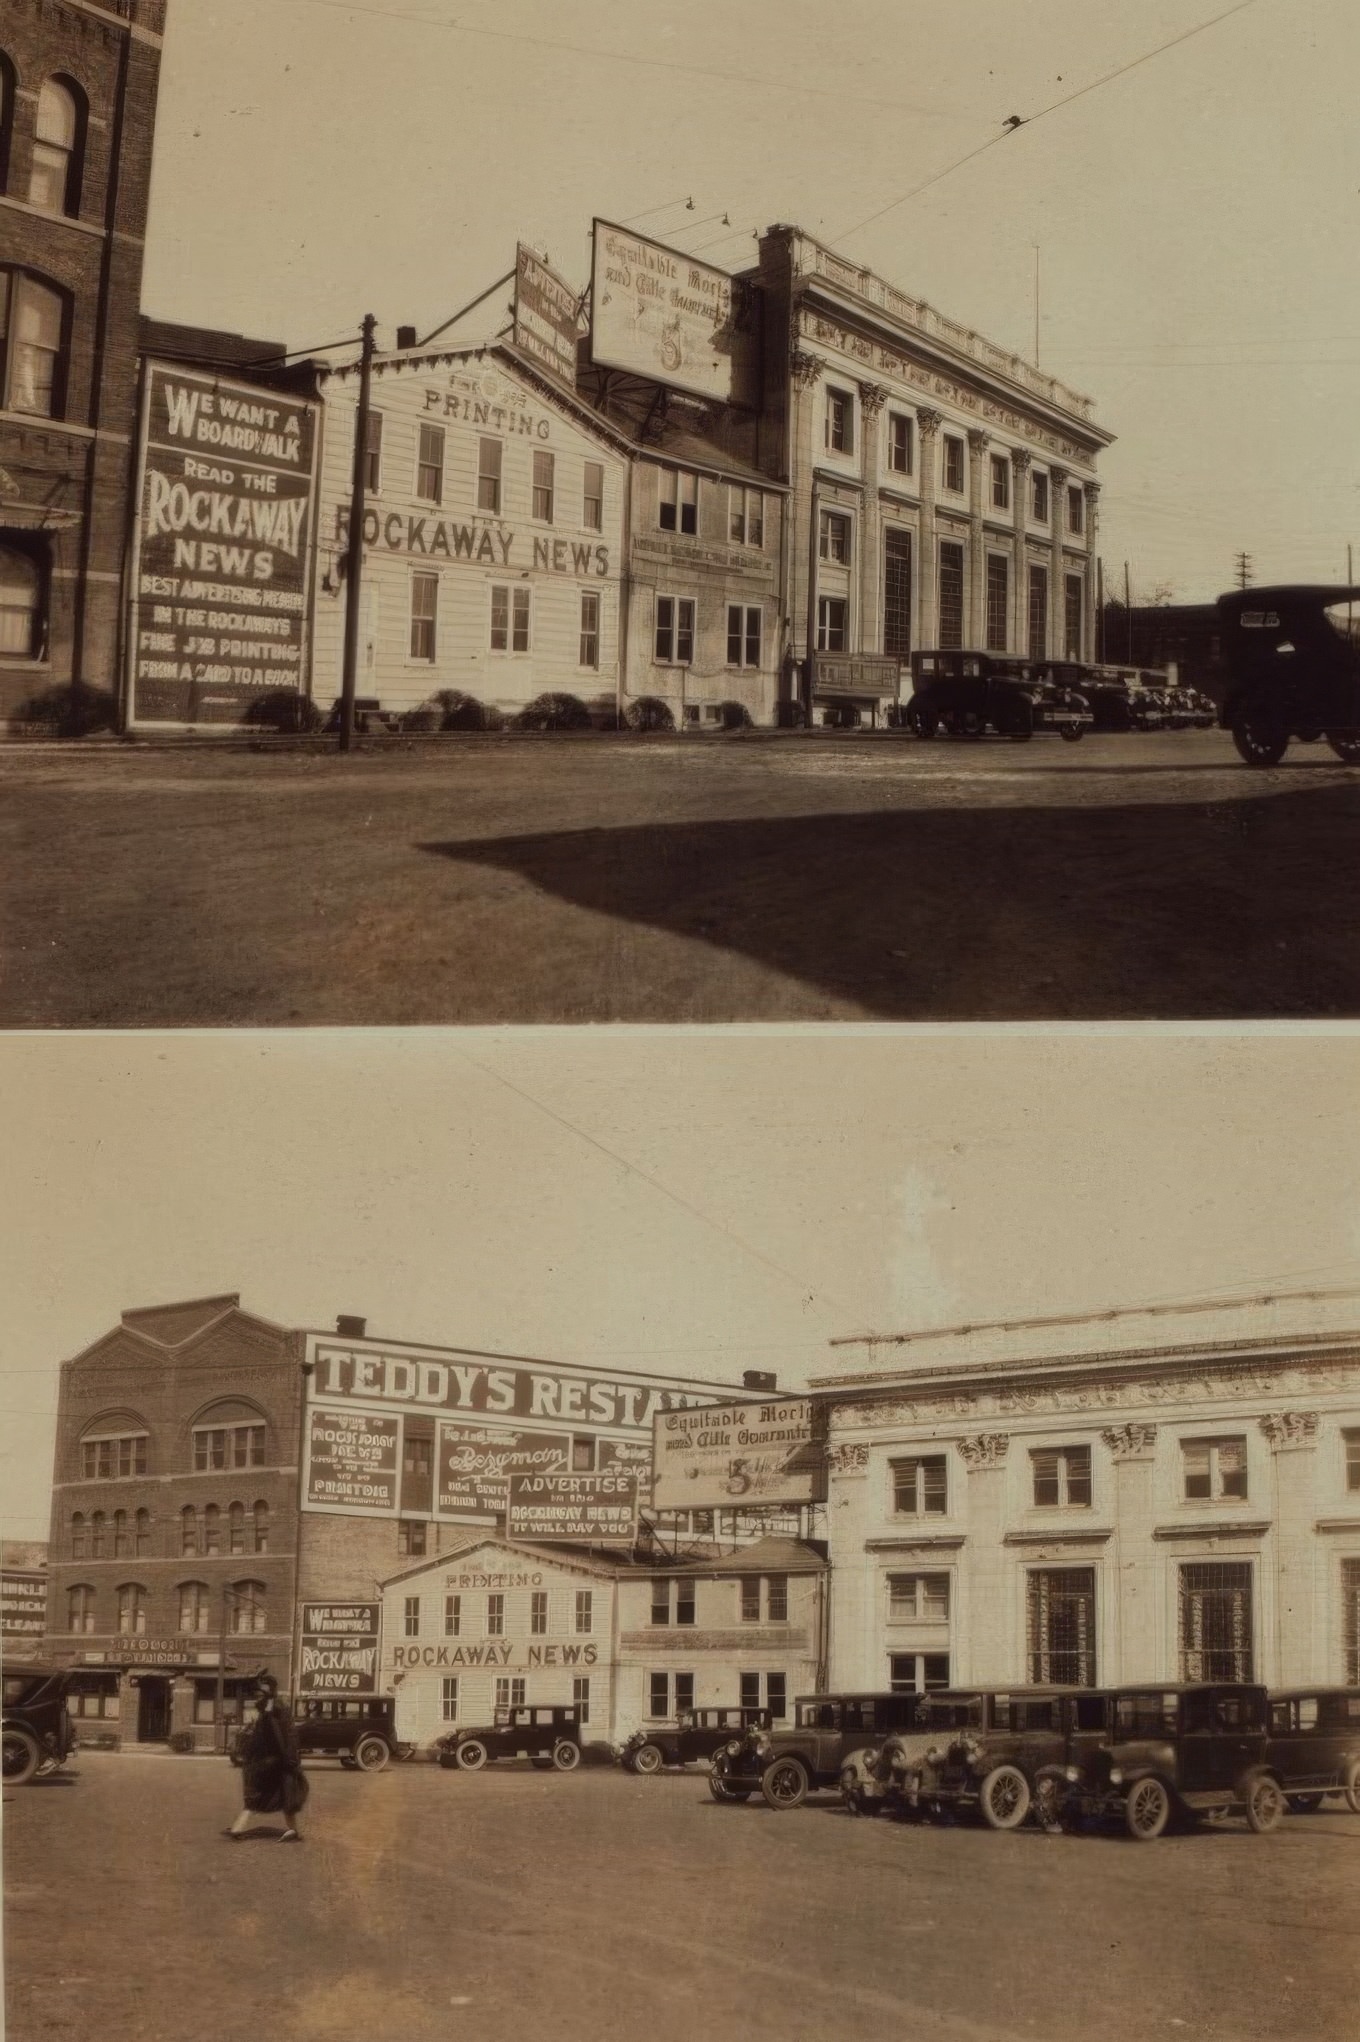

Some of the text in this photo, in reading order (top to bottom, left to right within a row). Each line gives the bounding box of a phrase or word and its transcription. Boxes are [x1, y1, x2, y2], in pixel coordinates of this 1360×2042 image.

[220, 396, 280, 429] WANT
[283, 415, 300, 435] A
[424, 389, 550, 440] PRINTING
[197, 418, 301, 463] BOARDWALK
[184, 457, 277, 493] READ THE
[146, 469, 307, 557] ROCKAWAY
[335, 505, 514, 566] ROCKAWAY
[533, 537, 609, 577] NEWS
[174, 538, 274, 579] NEWS
[139, 574, 179, 597] BEST
[153, 605, 291, 636] IN THE ROCKAWAYS
[139, 631, 176, 652] FINE
[179, 662, 193, 681] A
[234, 667, 251, 684] TO
[252, 668, 263, 685] A
[318, 1349, 517, 1411] TEDDY'S
[518, 1476, 630, 1493] ADVERTISE
[530, 1523, 565, 1533] WILL
[599, 1523, 629, 1534] YOU
[446, 1572, 543, 1588] PRINTING
[393, 1643, 599, 1667] ROCKAWAY NEWS
